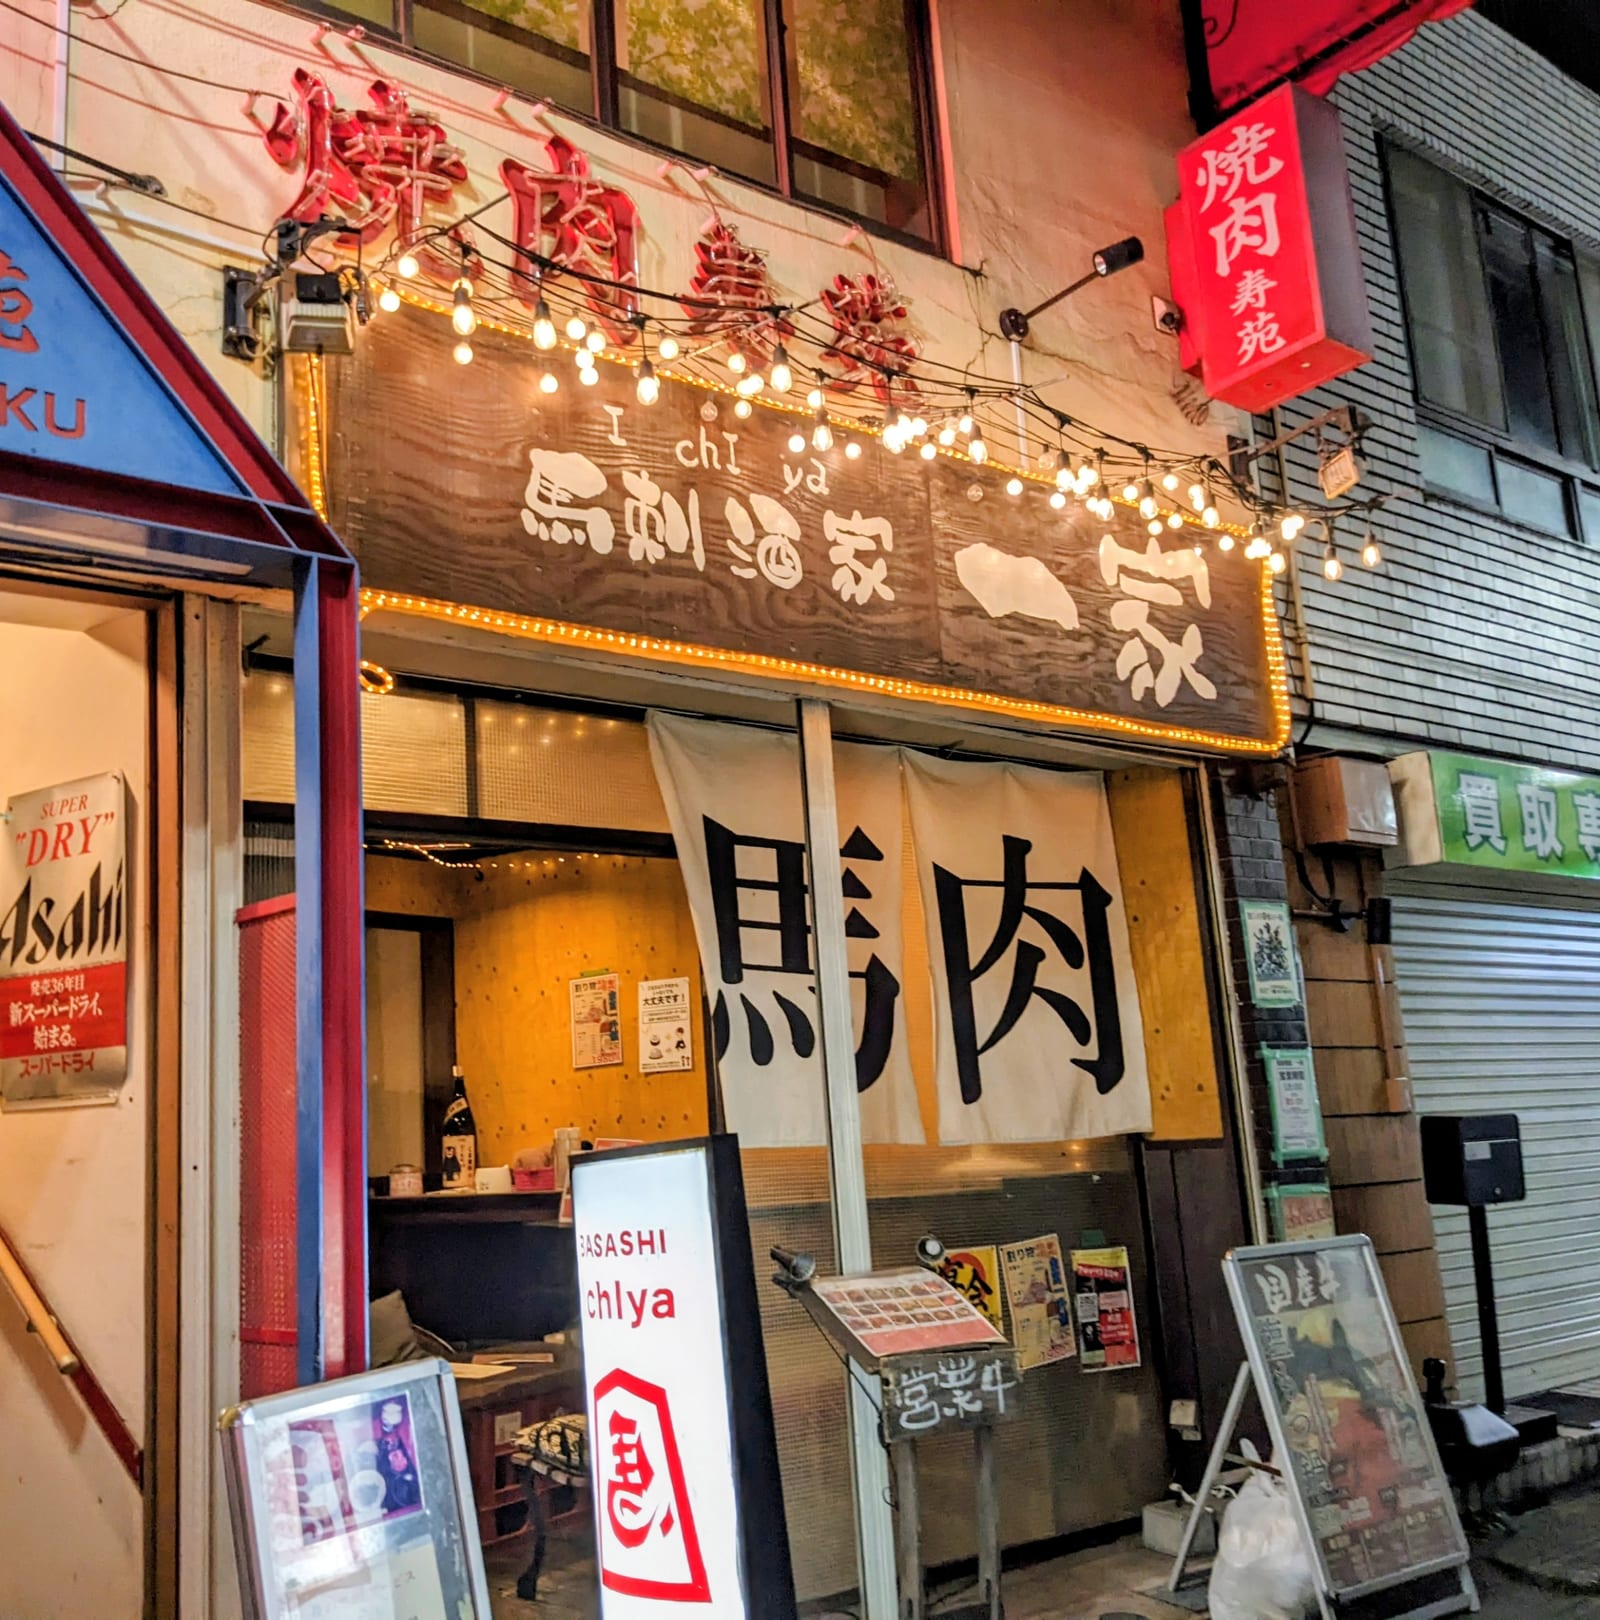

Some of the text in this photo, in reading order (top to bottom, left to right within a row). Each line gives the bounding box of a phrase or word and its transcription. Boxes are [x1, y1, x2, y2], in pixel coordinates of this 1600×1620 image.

[40, 795, 88, 820] SUPER
[0, 857, 123, 967] Asahi
[702, 814, 1124, 1105] 馬肉
[19, 1051, 94, 1078] スーパードライ
